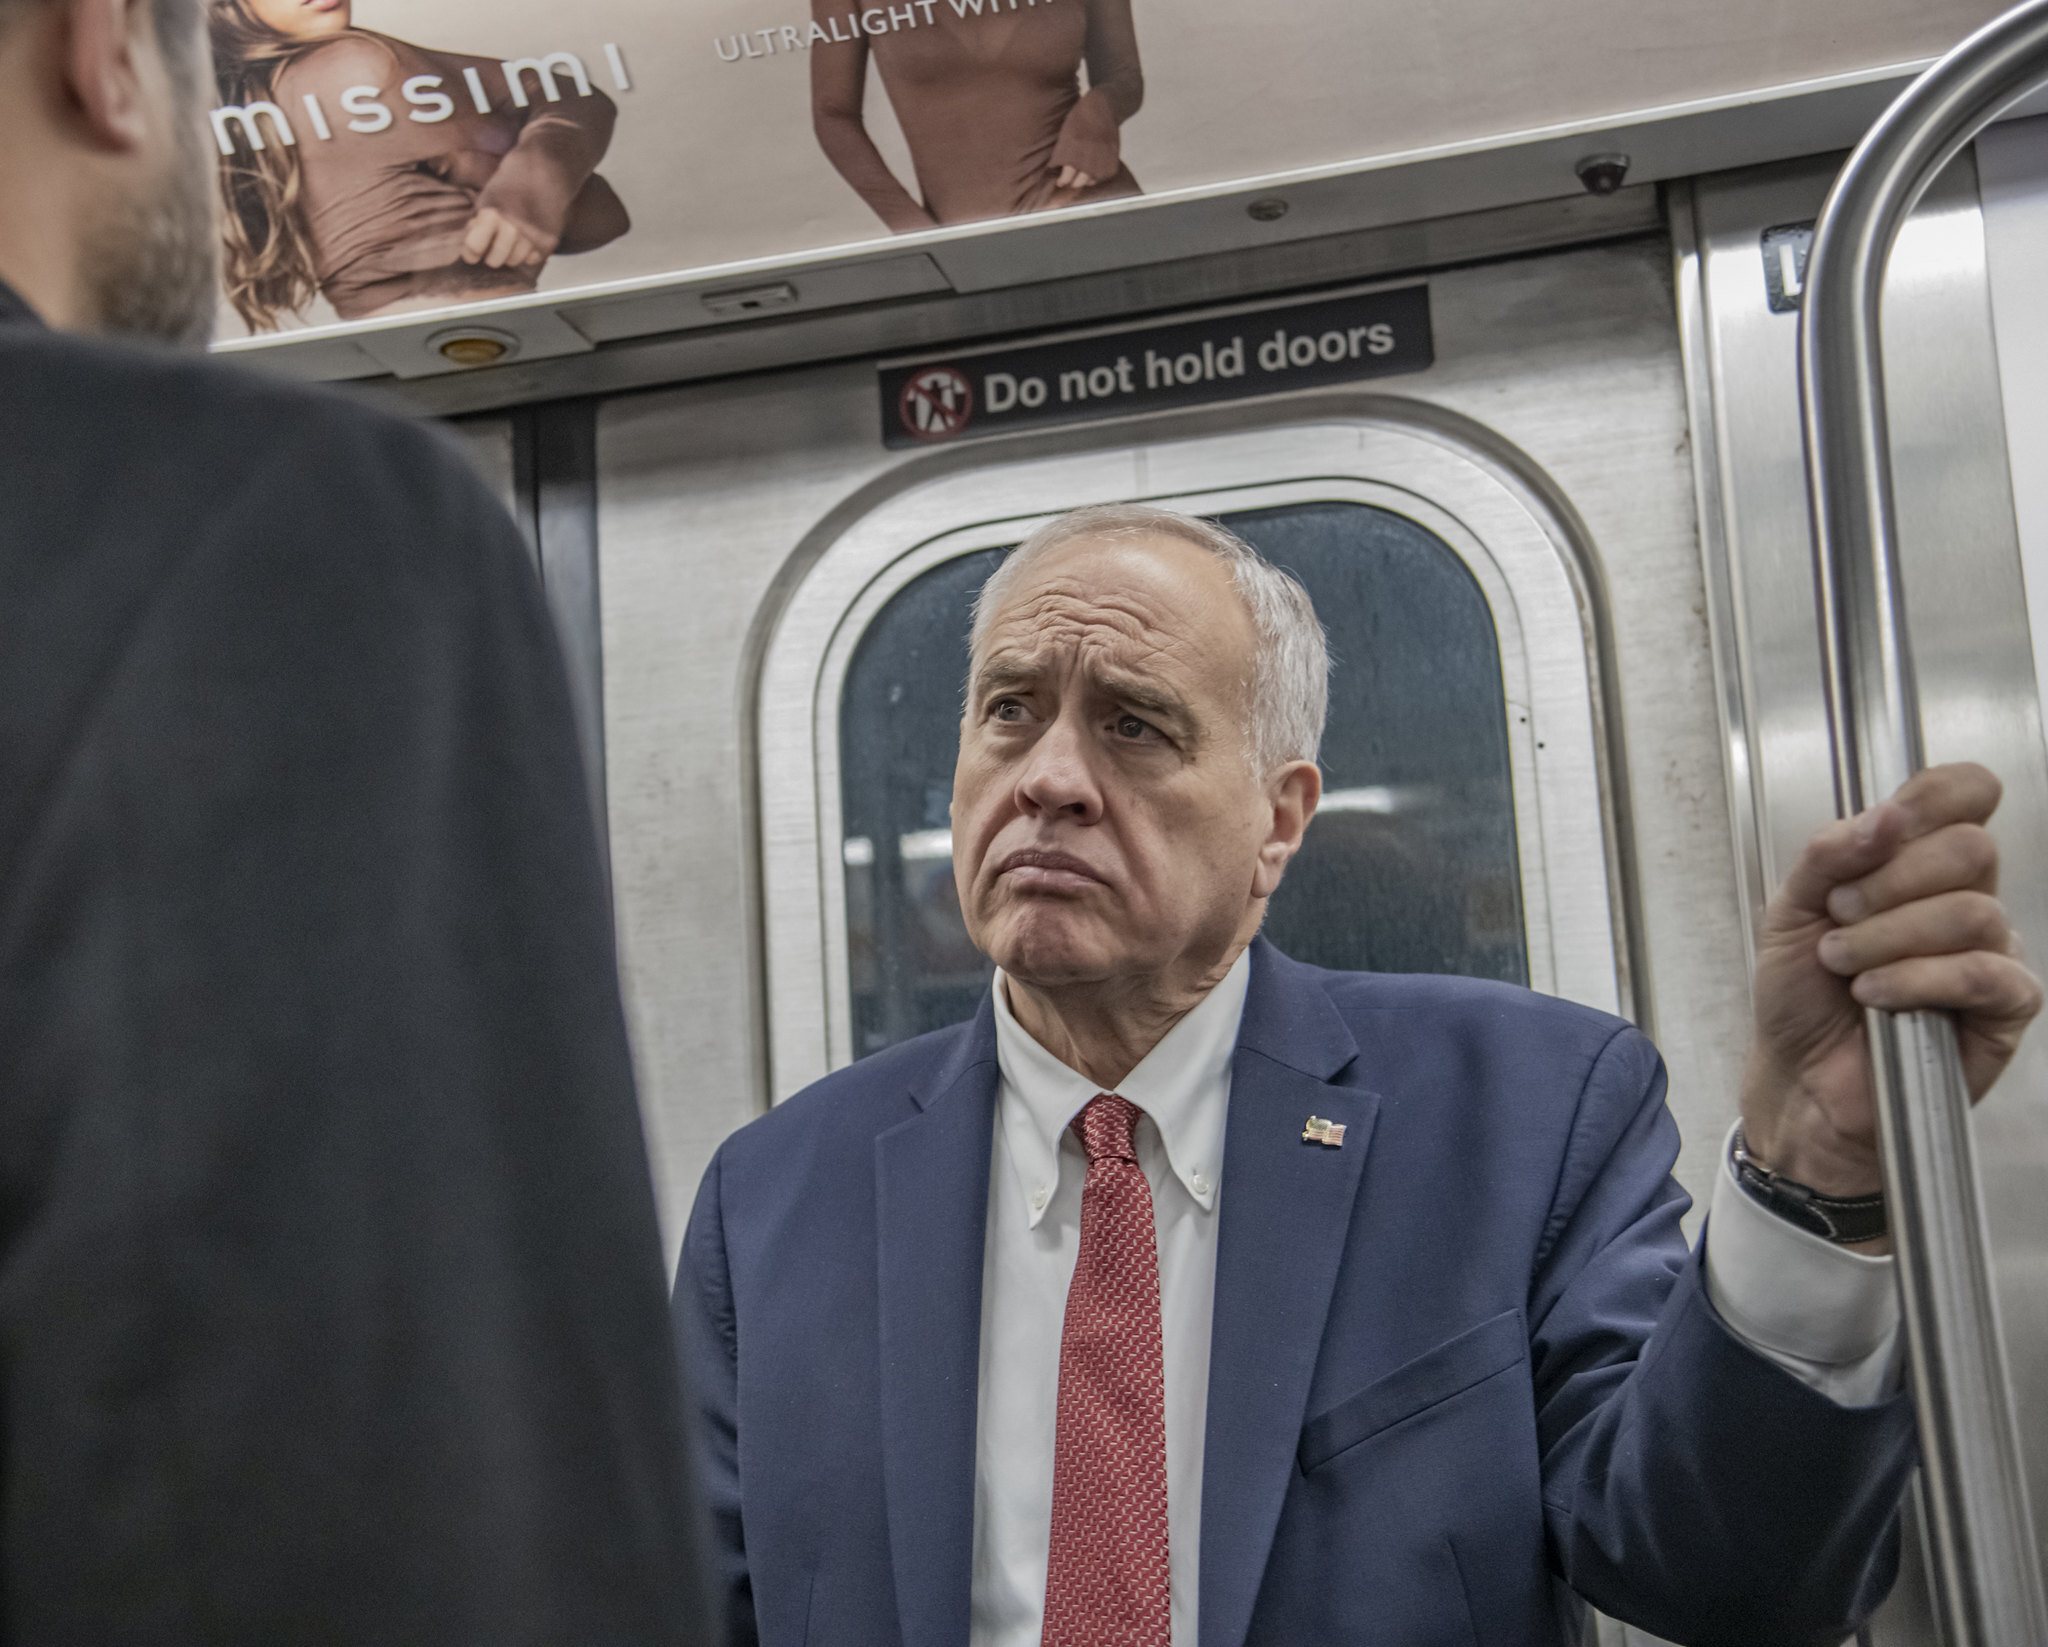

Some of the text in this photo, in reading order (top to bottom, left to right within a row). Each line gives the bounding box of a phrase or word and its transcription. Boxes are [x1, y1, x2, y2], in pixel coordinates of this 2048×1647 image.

[714, 0, 938, 62] ULTRALIGHT
[984, 324, 1395, 413] Do not hold doors
